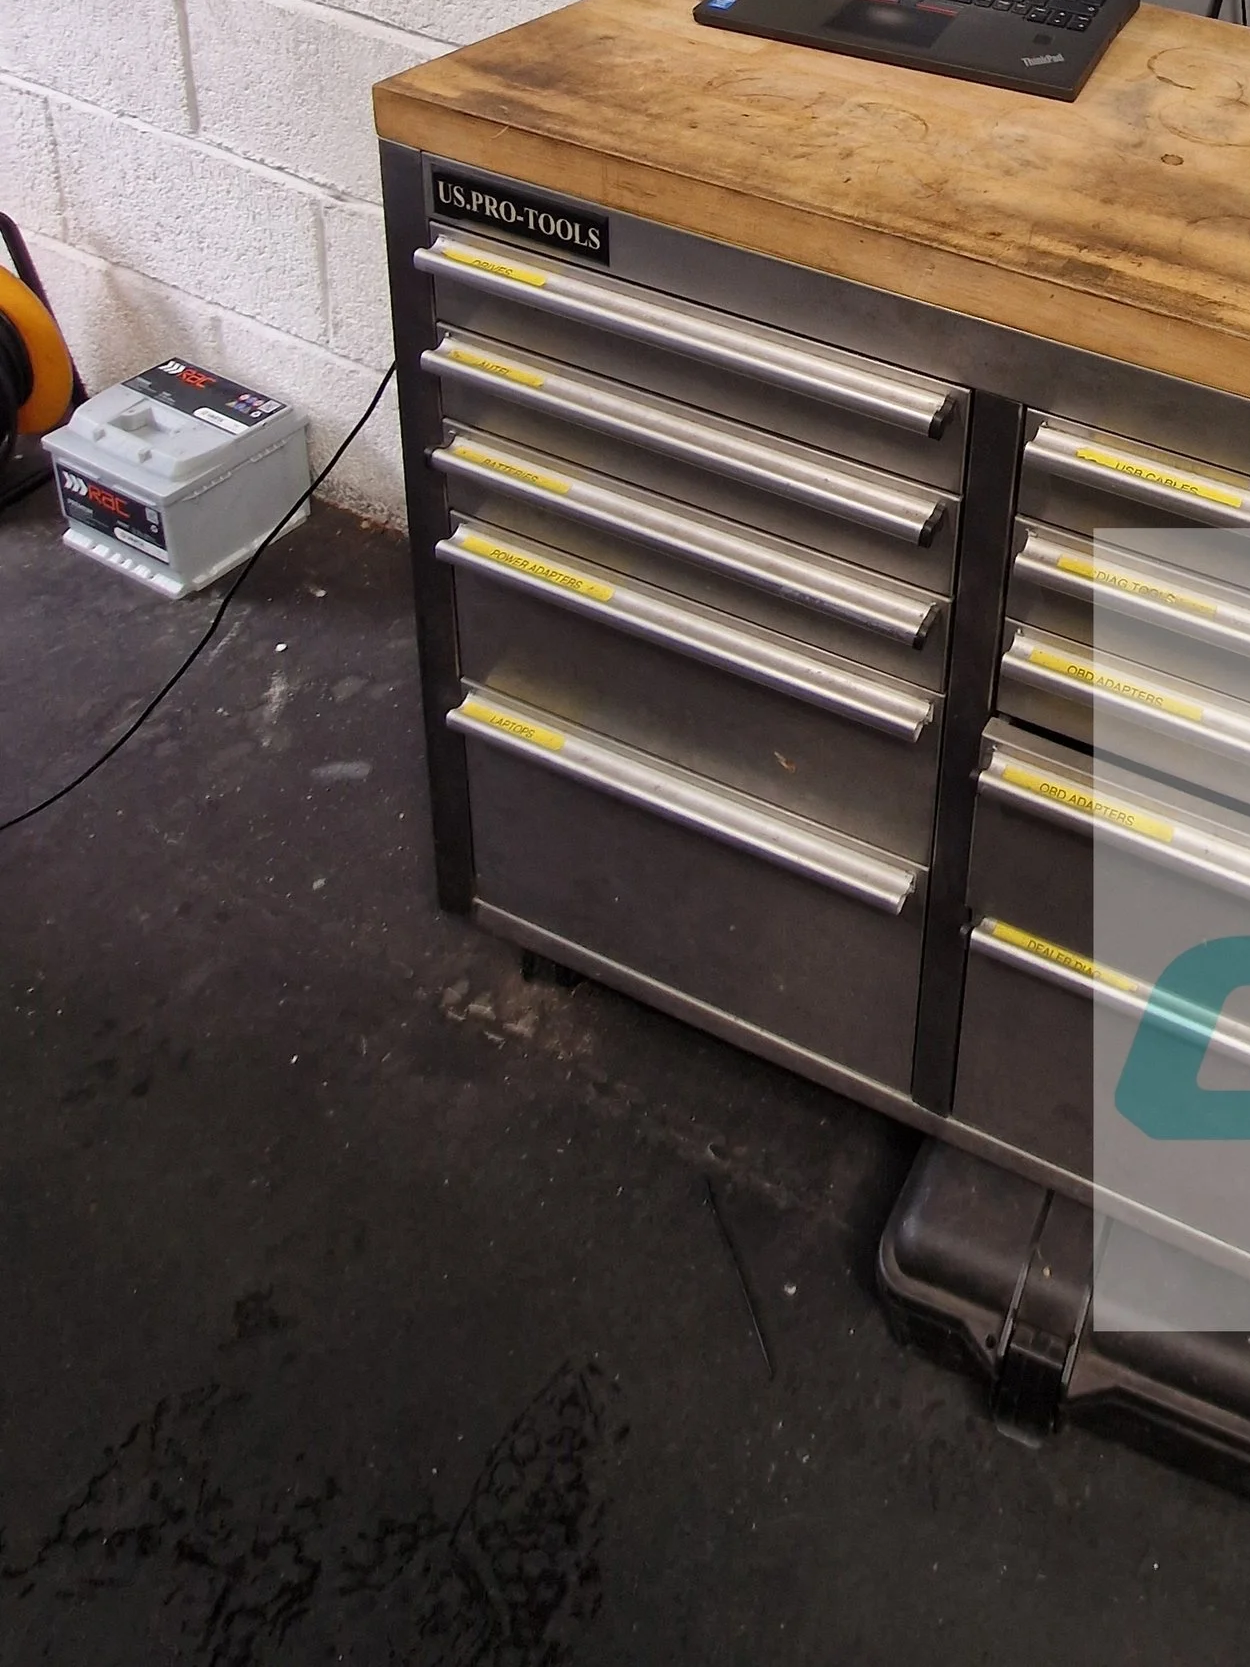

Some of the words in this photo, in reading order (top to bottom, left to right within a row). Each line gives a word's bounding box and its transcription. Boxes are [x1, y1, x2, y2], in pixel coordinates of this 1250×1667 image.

[1021, 53, 1065, 68] ThinkPad
[437, 180, 601, 251] US.PRO-TOOLS
[1114, 462, 1143, 477] USB
[490, 548, 530, 568] POWER
[529, 563, 584, 590] ADAPTERS
[1096, 570, 1128, 588] DIAG
[1066, 664, 1094, 682] OBD
[1096, 676, 1165, 707] ADAPTERS
[489, 714, 536, 739] LAPTOPS
[1039, 782, 1067, 800] OBD
[1069, 793, 1135, 827] ADAPTERS
[1027, 939, 1072, 967] DEALER
